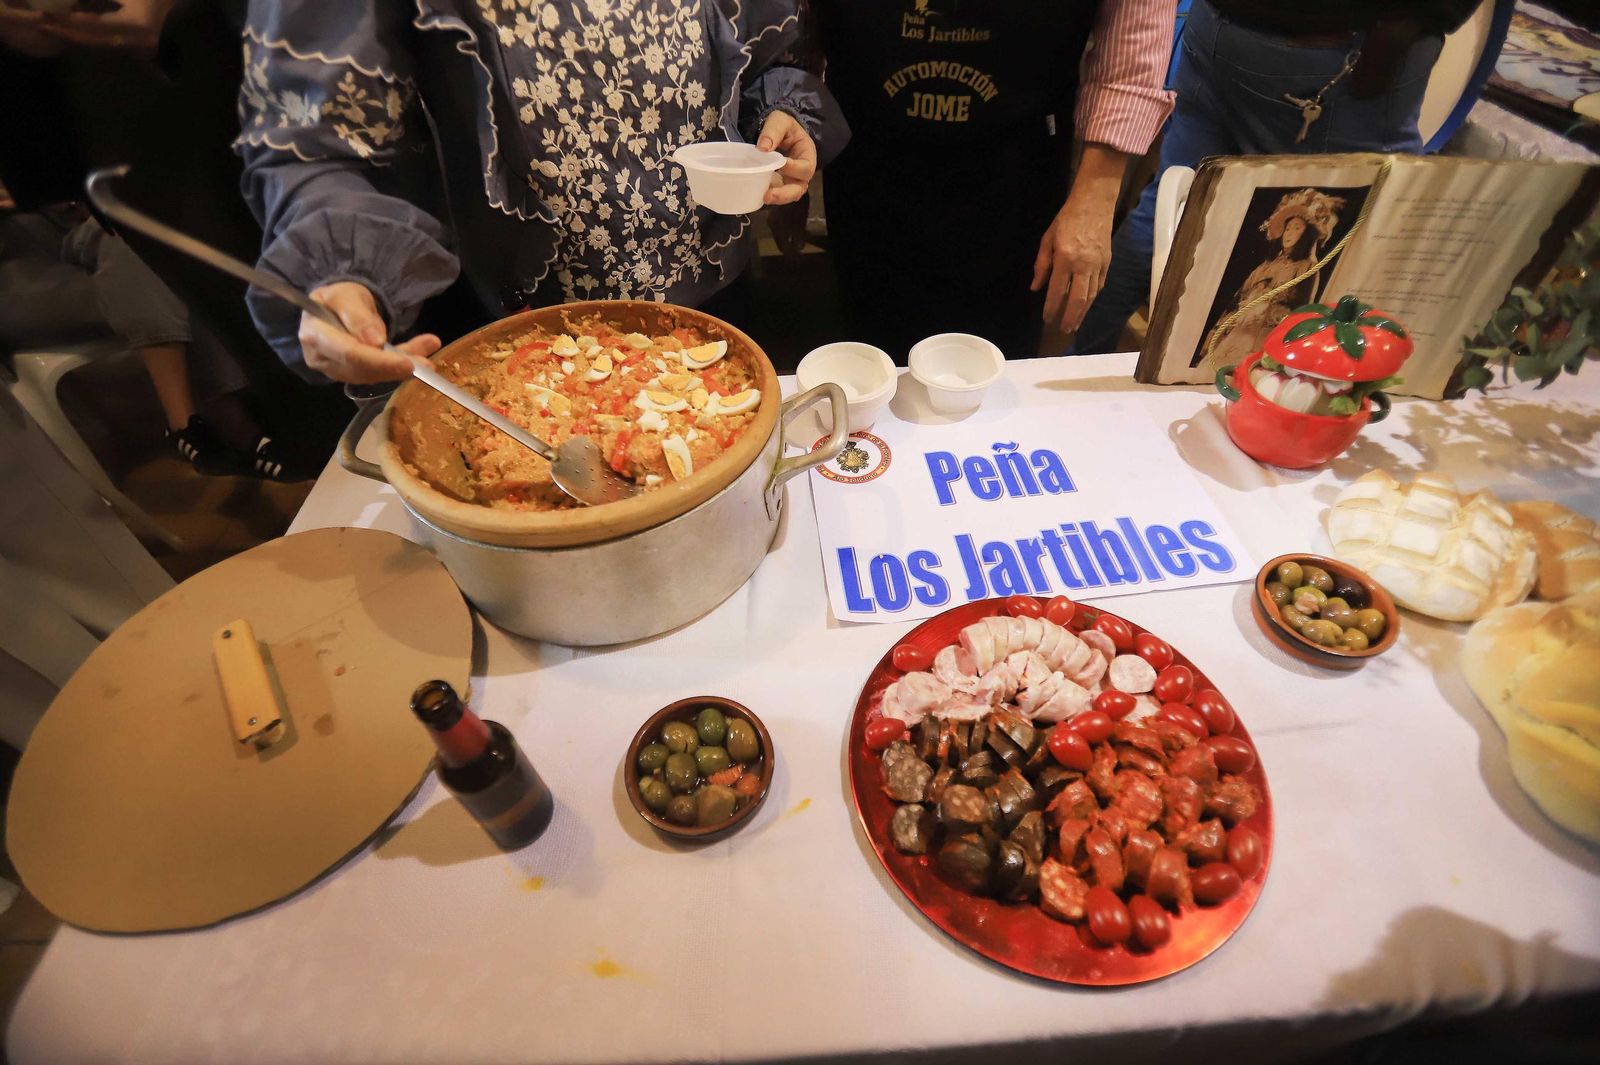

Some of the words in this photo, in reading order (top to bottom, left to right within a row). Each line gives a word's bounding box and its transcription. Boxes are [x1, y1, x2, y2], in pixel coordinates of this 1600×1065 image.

[902, 23, 925, 39] Los
[928, 26, 992, 42] Jartibles
[903, 12, 926, 25] Peña
[883, 61, 999, 103] AUTOMOCIÓN
[906, 92, 972, 122] JOME
[924, 440, 1078, 506] Peña
[836, 545, 952, 614] Los
[954, 517, 1237, 602] Jartibles
